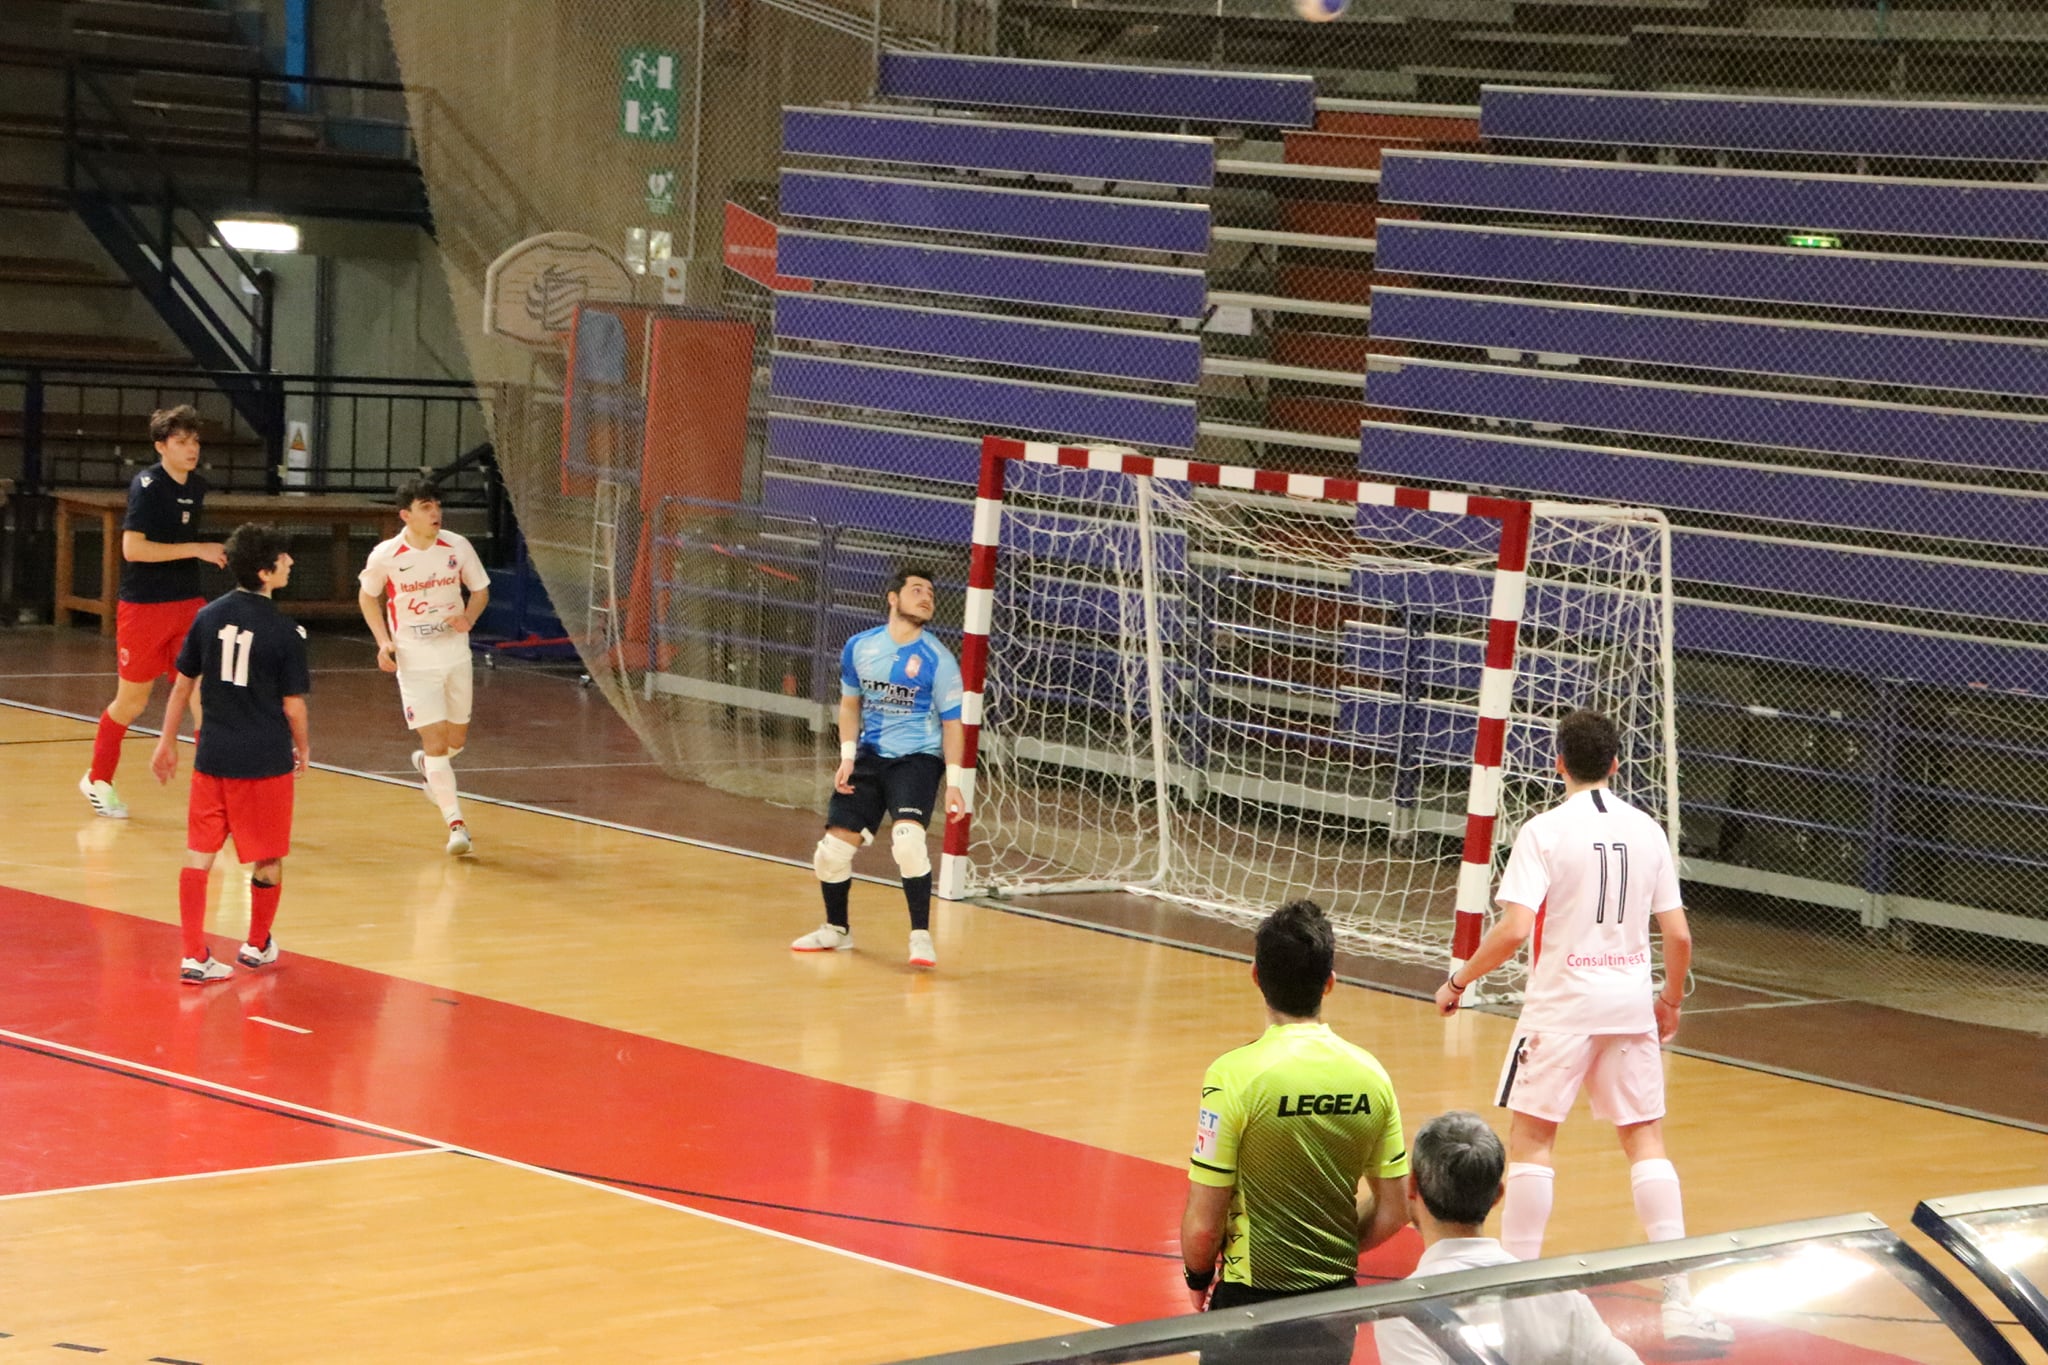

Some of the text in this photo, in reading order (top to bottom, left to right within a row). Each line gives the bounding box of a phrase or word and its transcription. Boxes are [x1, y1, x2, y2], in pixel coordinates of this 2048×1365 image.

[217, 624, 255, 687] 11
[1593, 843, 1628, 924] 11
[1567, 953, 1646, 967] Consultinest
[1277, 1093, 1371, 1118] LEGEA
